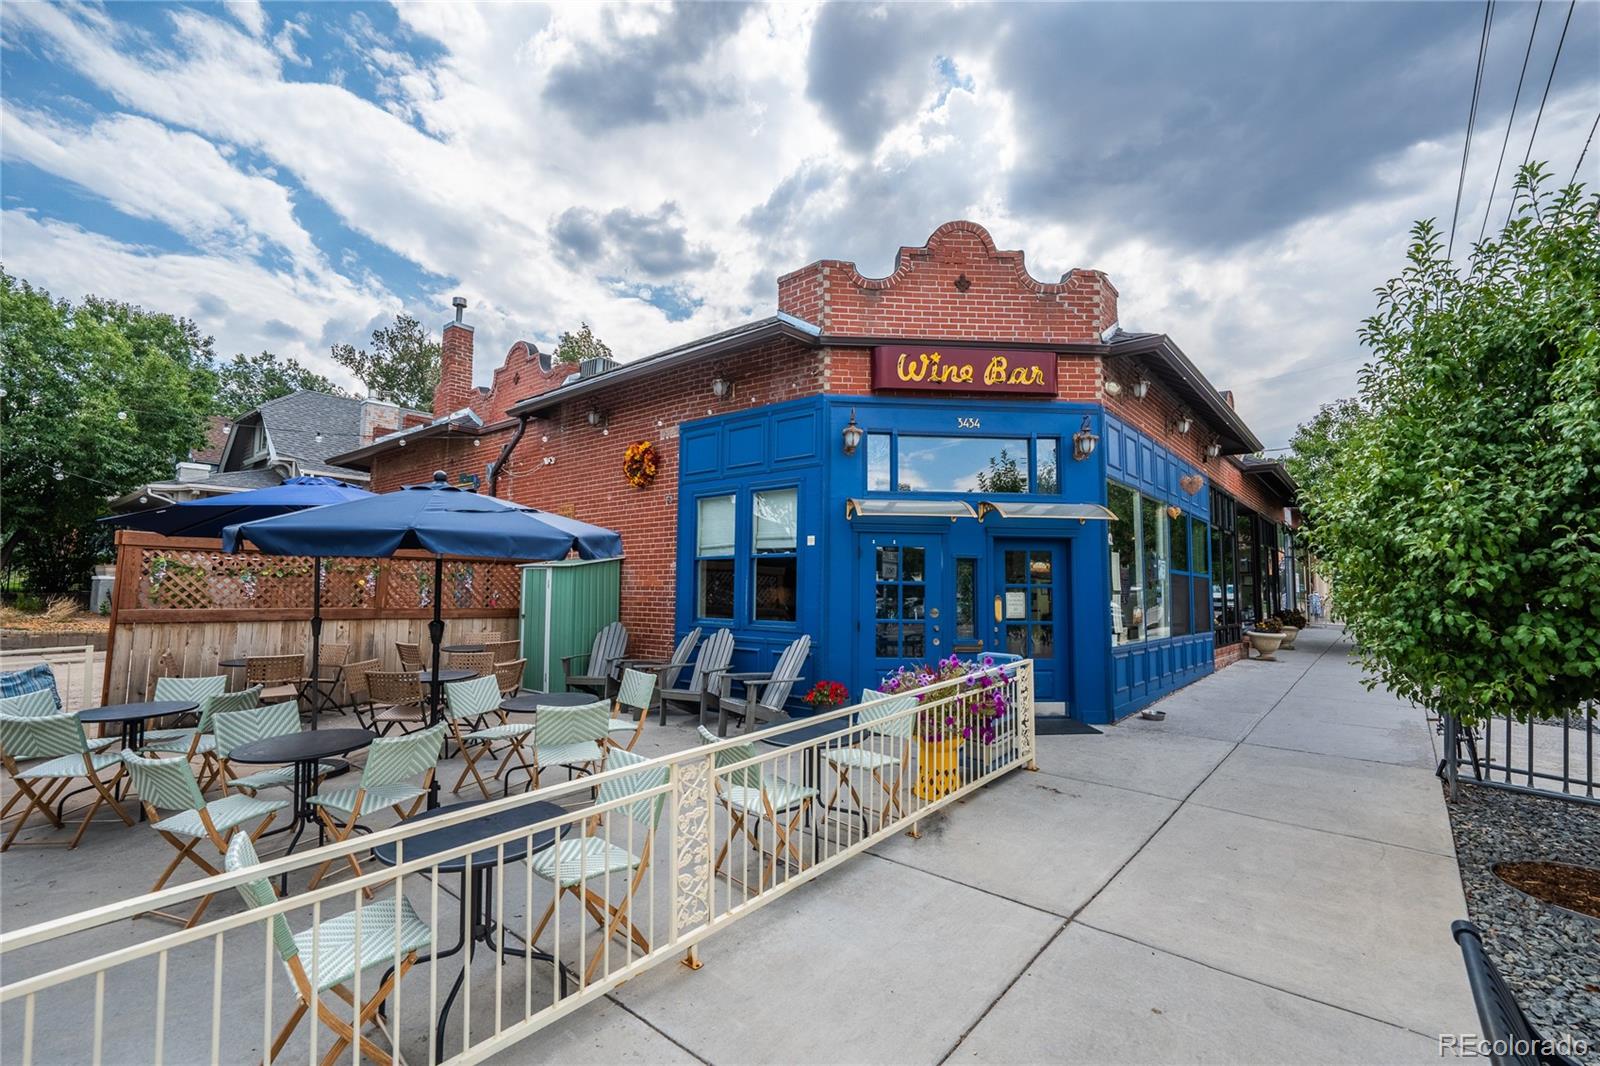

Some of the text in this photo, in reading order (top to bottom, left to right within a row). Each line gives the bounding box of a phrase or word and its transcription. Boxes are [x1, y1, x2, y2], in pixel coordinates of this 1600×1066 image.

[897, 352, 1045, 386] Wine Bar
[957, 417, 980, 429] 3434
